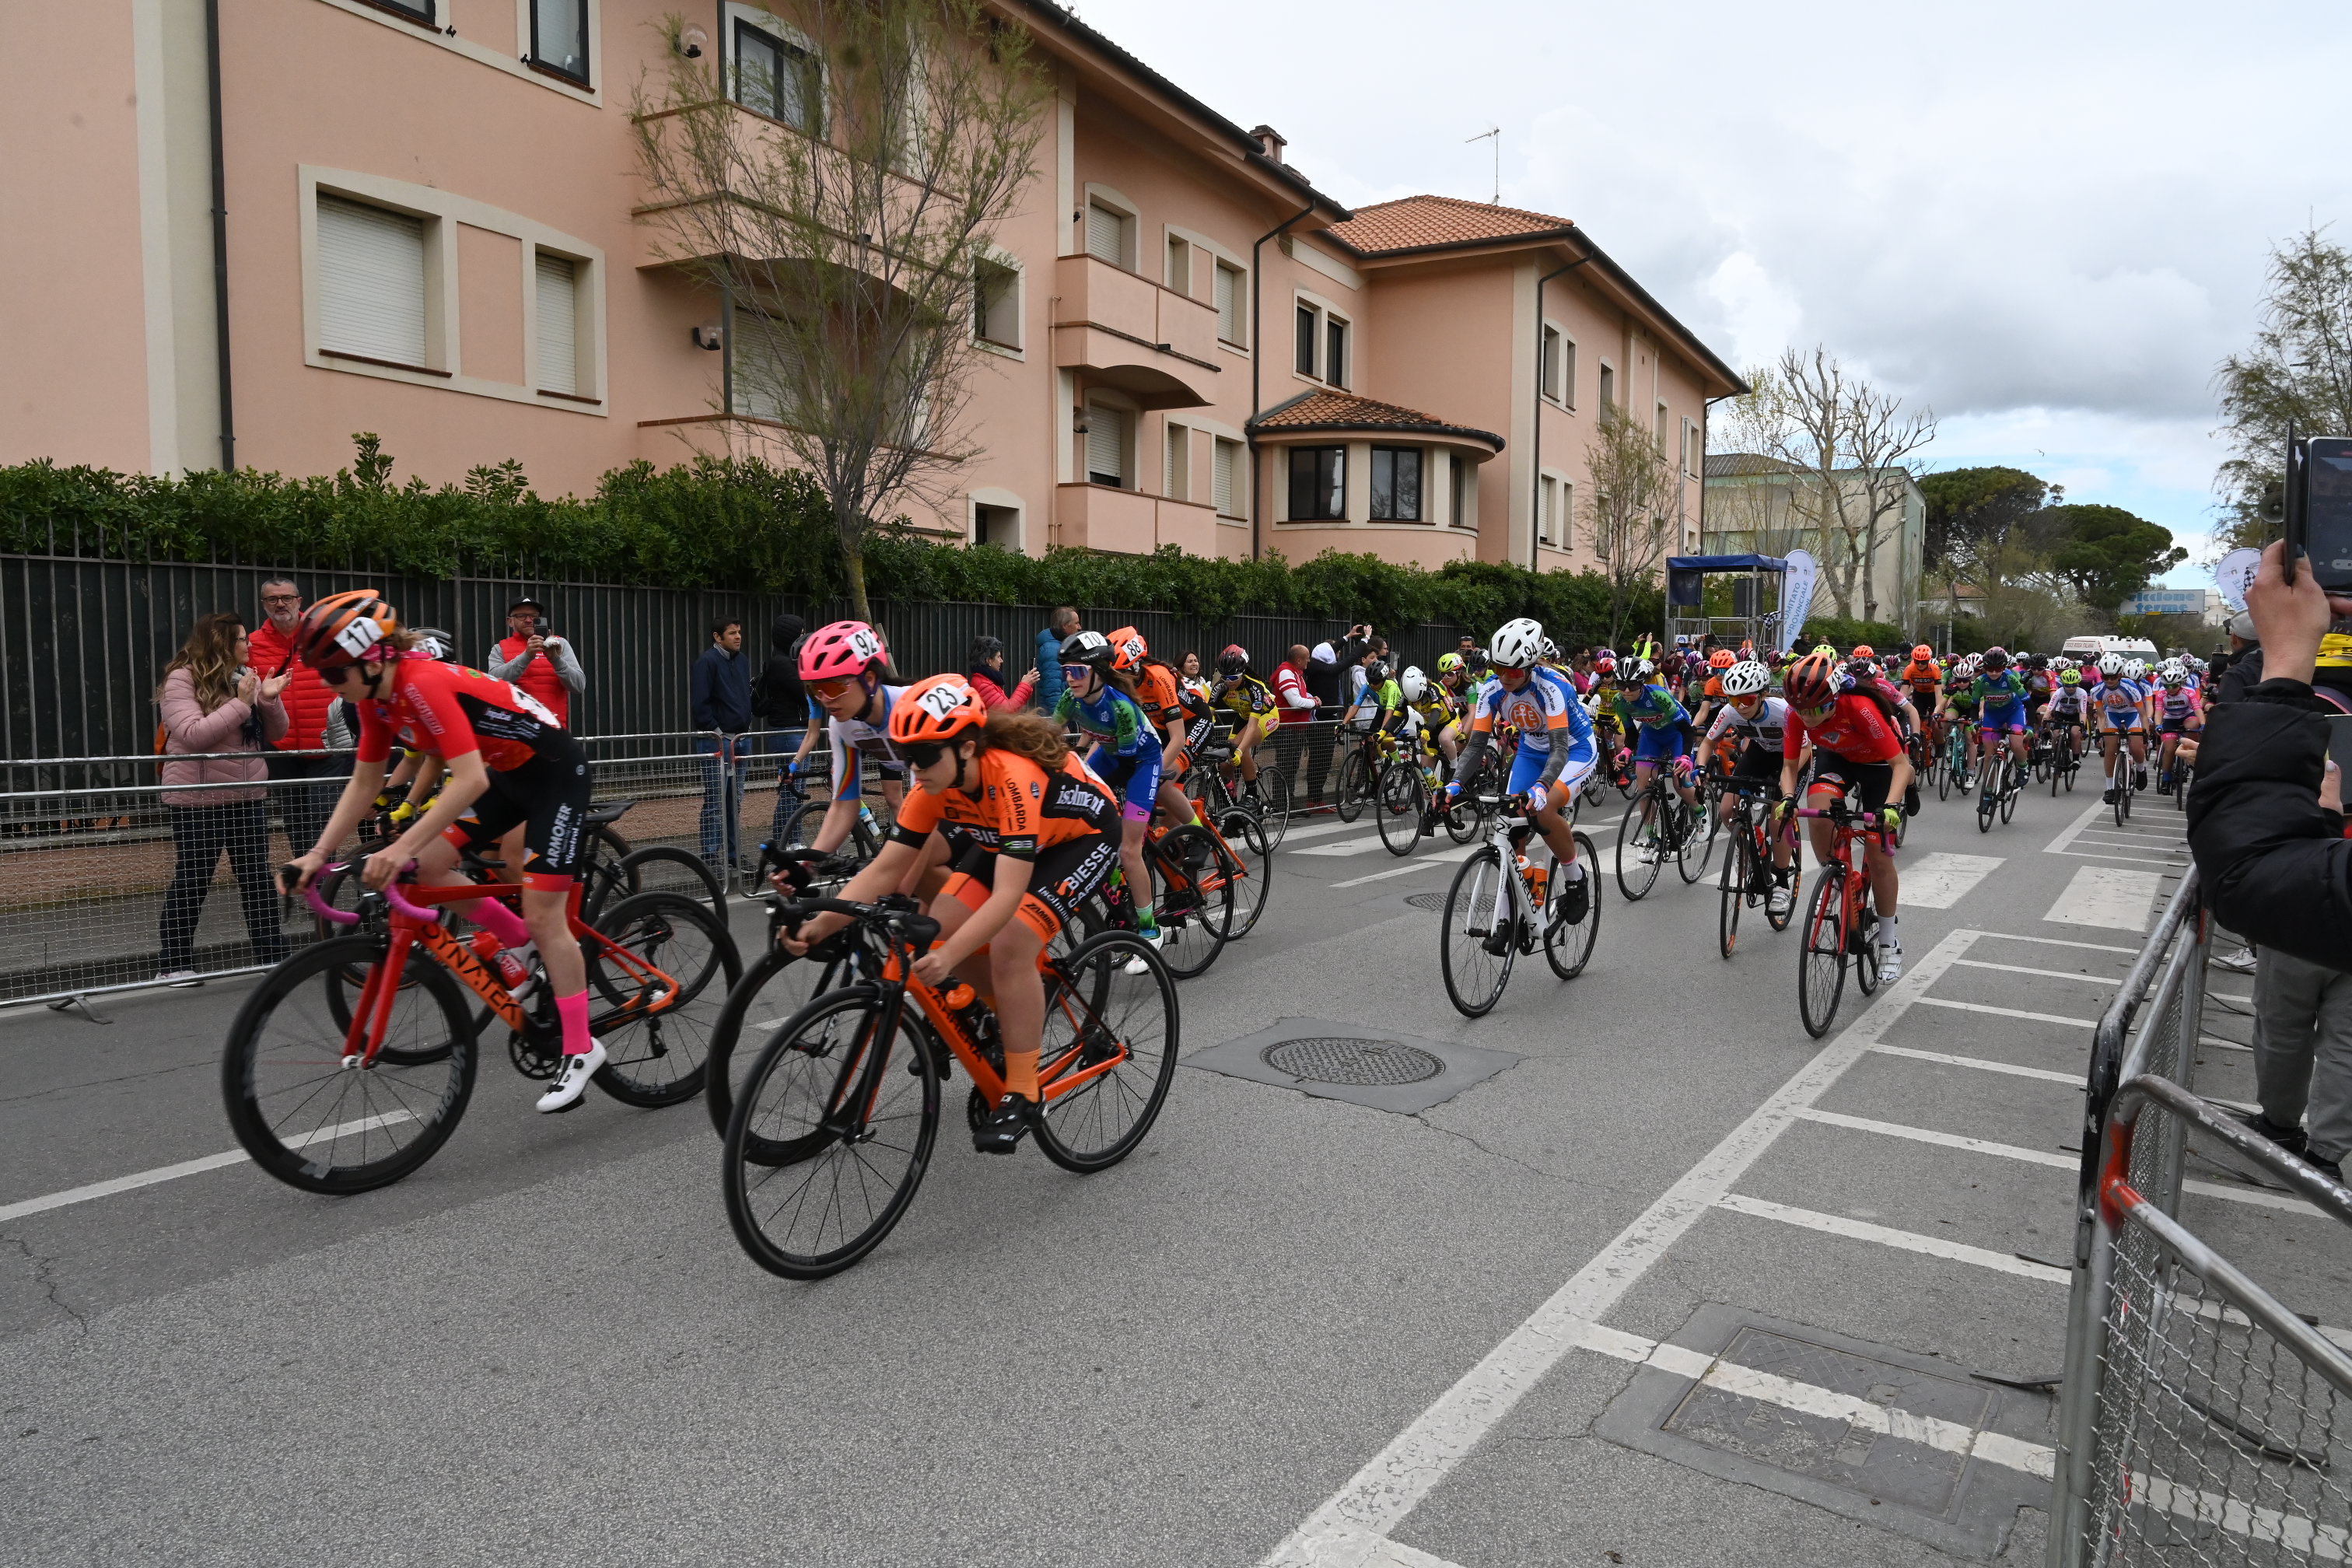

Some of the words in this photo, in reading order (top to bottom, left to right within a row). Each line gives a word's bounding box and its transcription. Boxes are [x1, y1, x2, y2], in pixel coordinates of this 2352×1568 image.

[1787, 580, 1808, 635] PROVINCIALE
[2135, 603, 2189, 613] terme
[347, 620, 374, 649] 17
[856, 629, 877, 657] 92
[1084, 632, 1101, 646] 10
[1126, 640, 1142, 657] 88
[1524, 642, 1538, 661] 94
[927, 687, 958, 716] 23
[1158, 675, 1175, 704] LOMBARDA
[1187, 718, 1208, 744] BIESSE
[1191, 722, 1213, 754] CARRERA
[1861, 709, 1885, 739] MANITOU
[1005, 778, 1027, 831] LOMBARDA
[546, 803, 572, 868] ARMOFER
[1062, 842, 1112, 891] BIESSE
[1508, 848, 1537, 915] PINARELLO
